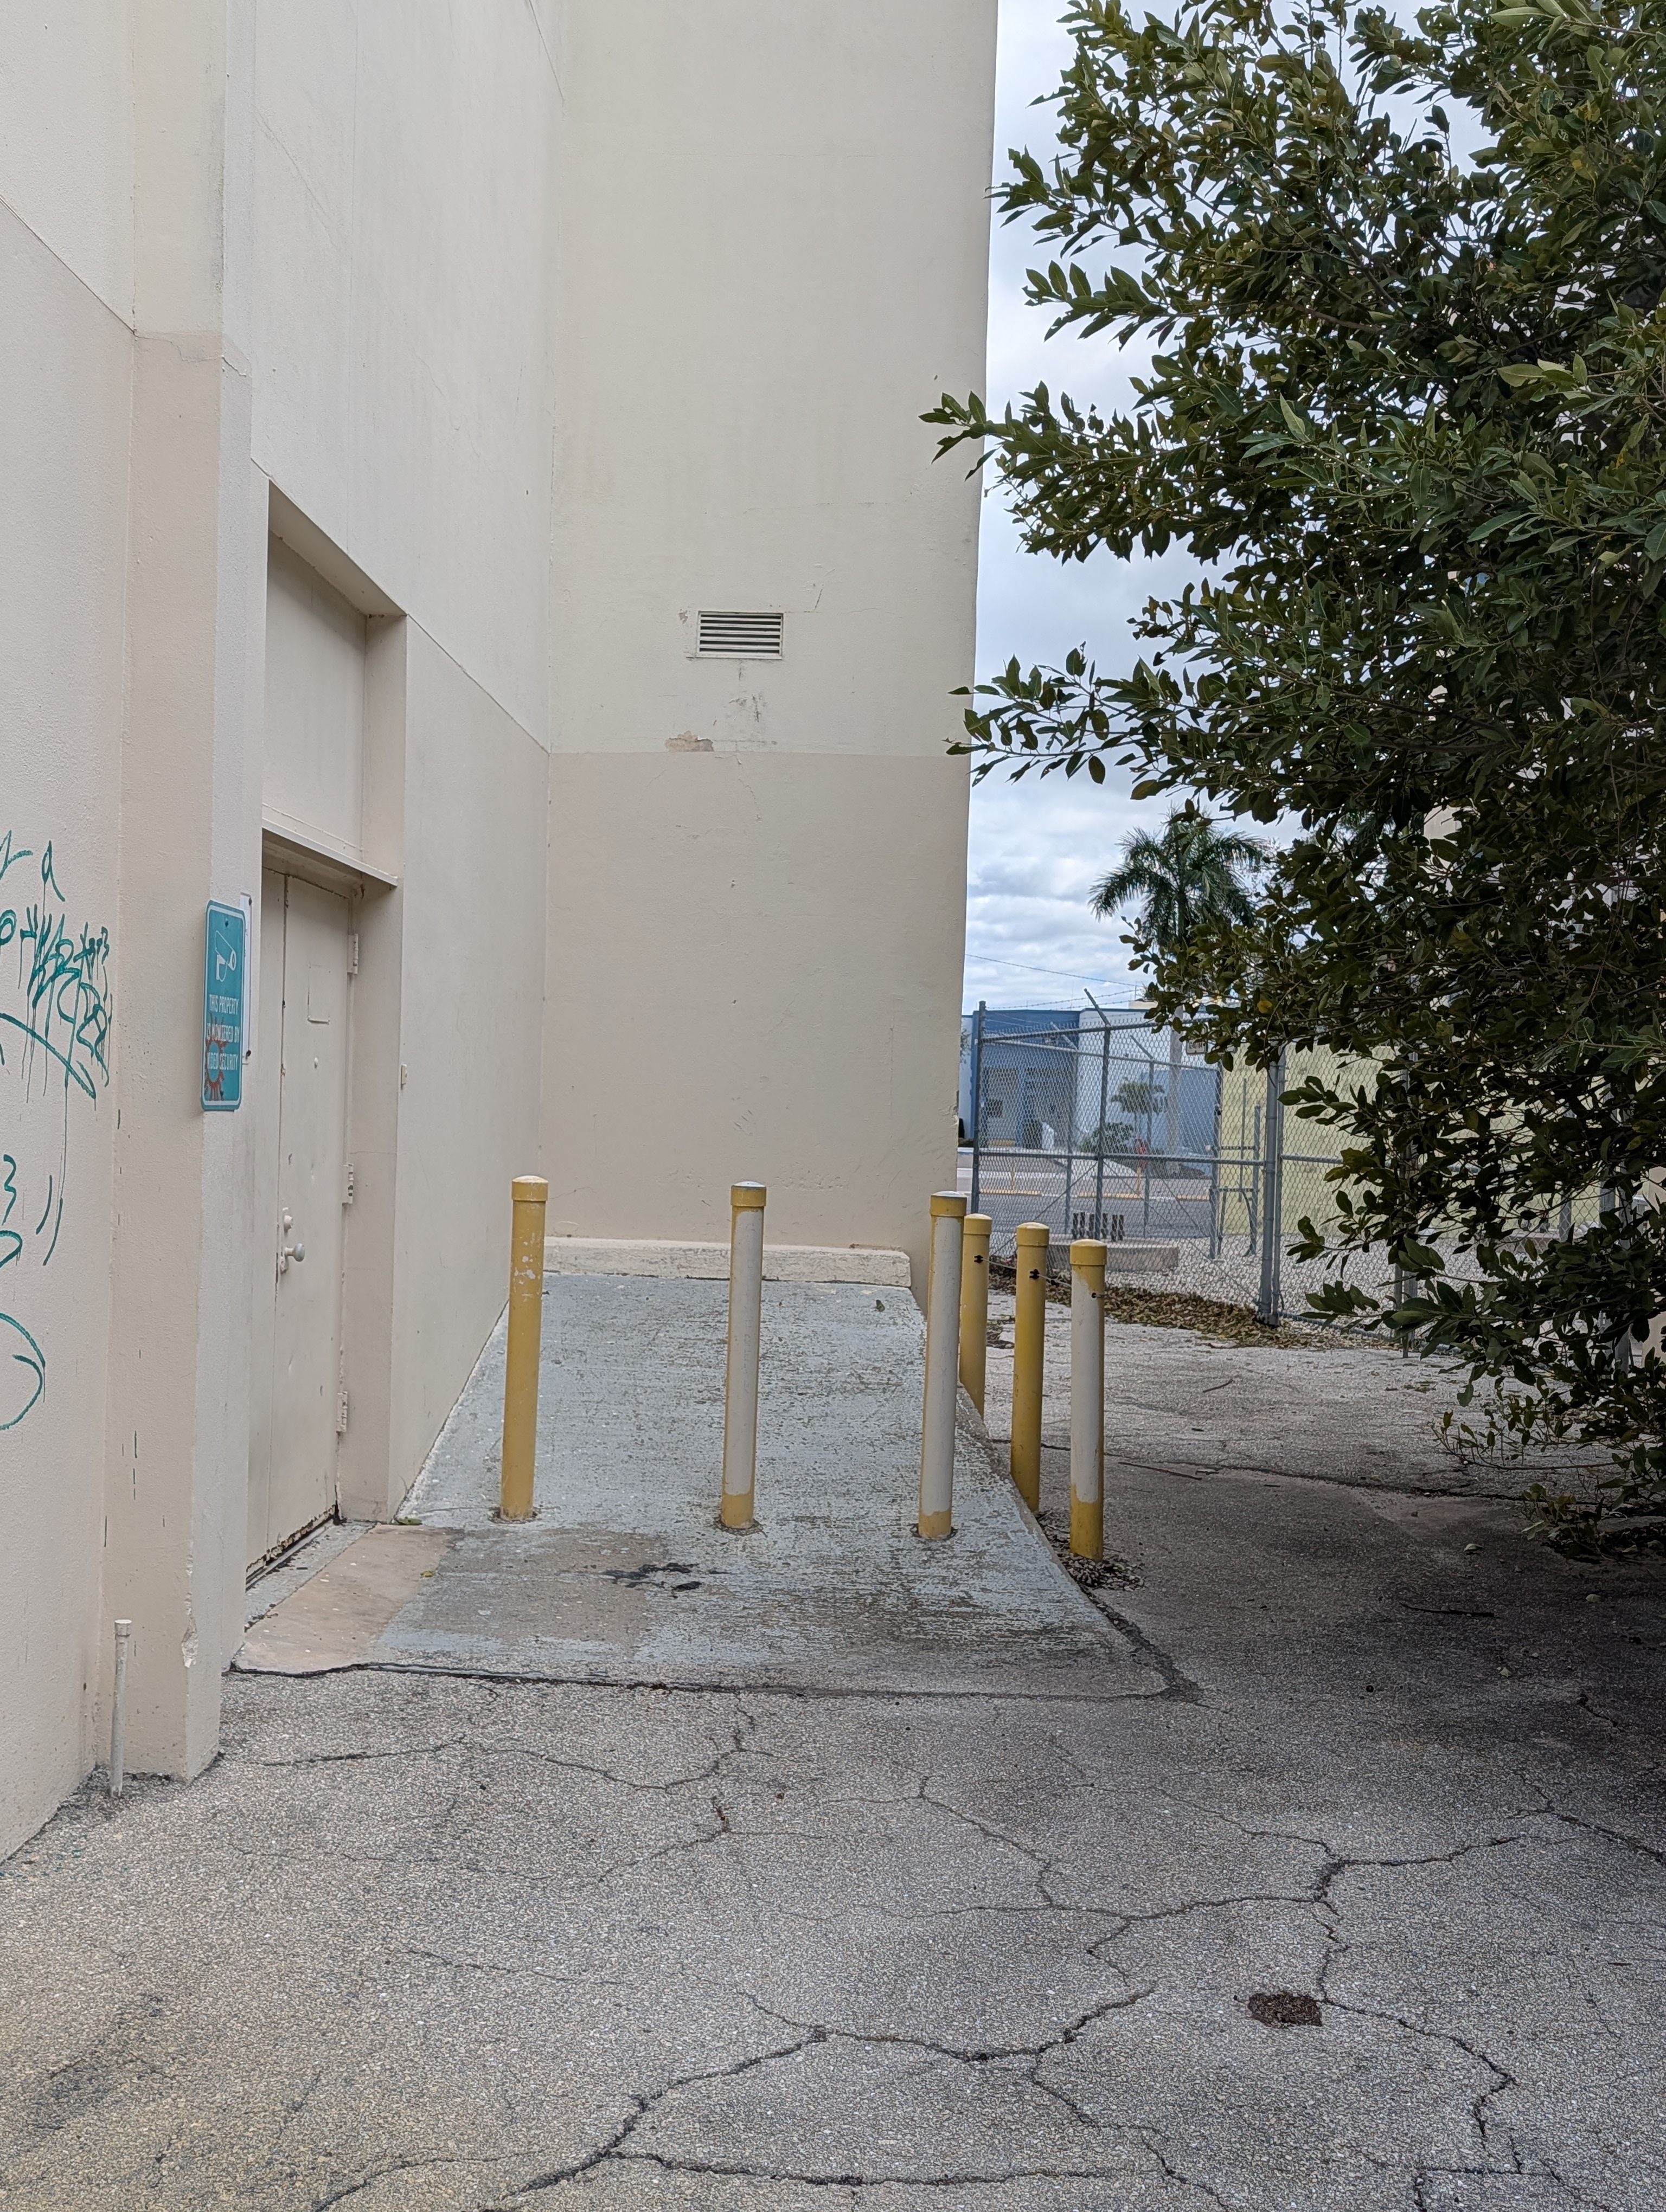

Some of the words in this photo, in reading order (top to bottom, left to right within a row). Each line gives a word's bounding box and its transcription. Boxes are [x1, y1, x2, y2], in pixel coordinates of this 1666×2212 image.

[209, 994, 218, 1012] THIS
[219, 996, 239, 1015] PROPERTY
[206, 1023, 211, 1041] IS
[234, 1026, 240, 1043] BY
[207, 1052, 219, 1070] VIDEO
[219, 1053, 239, 1070] SECURITY
